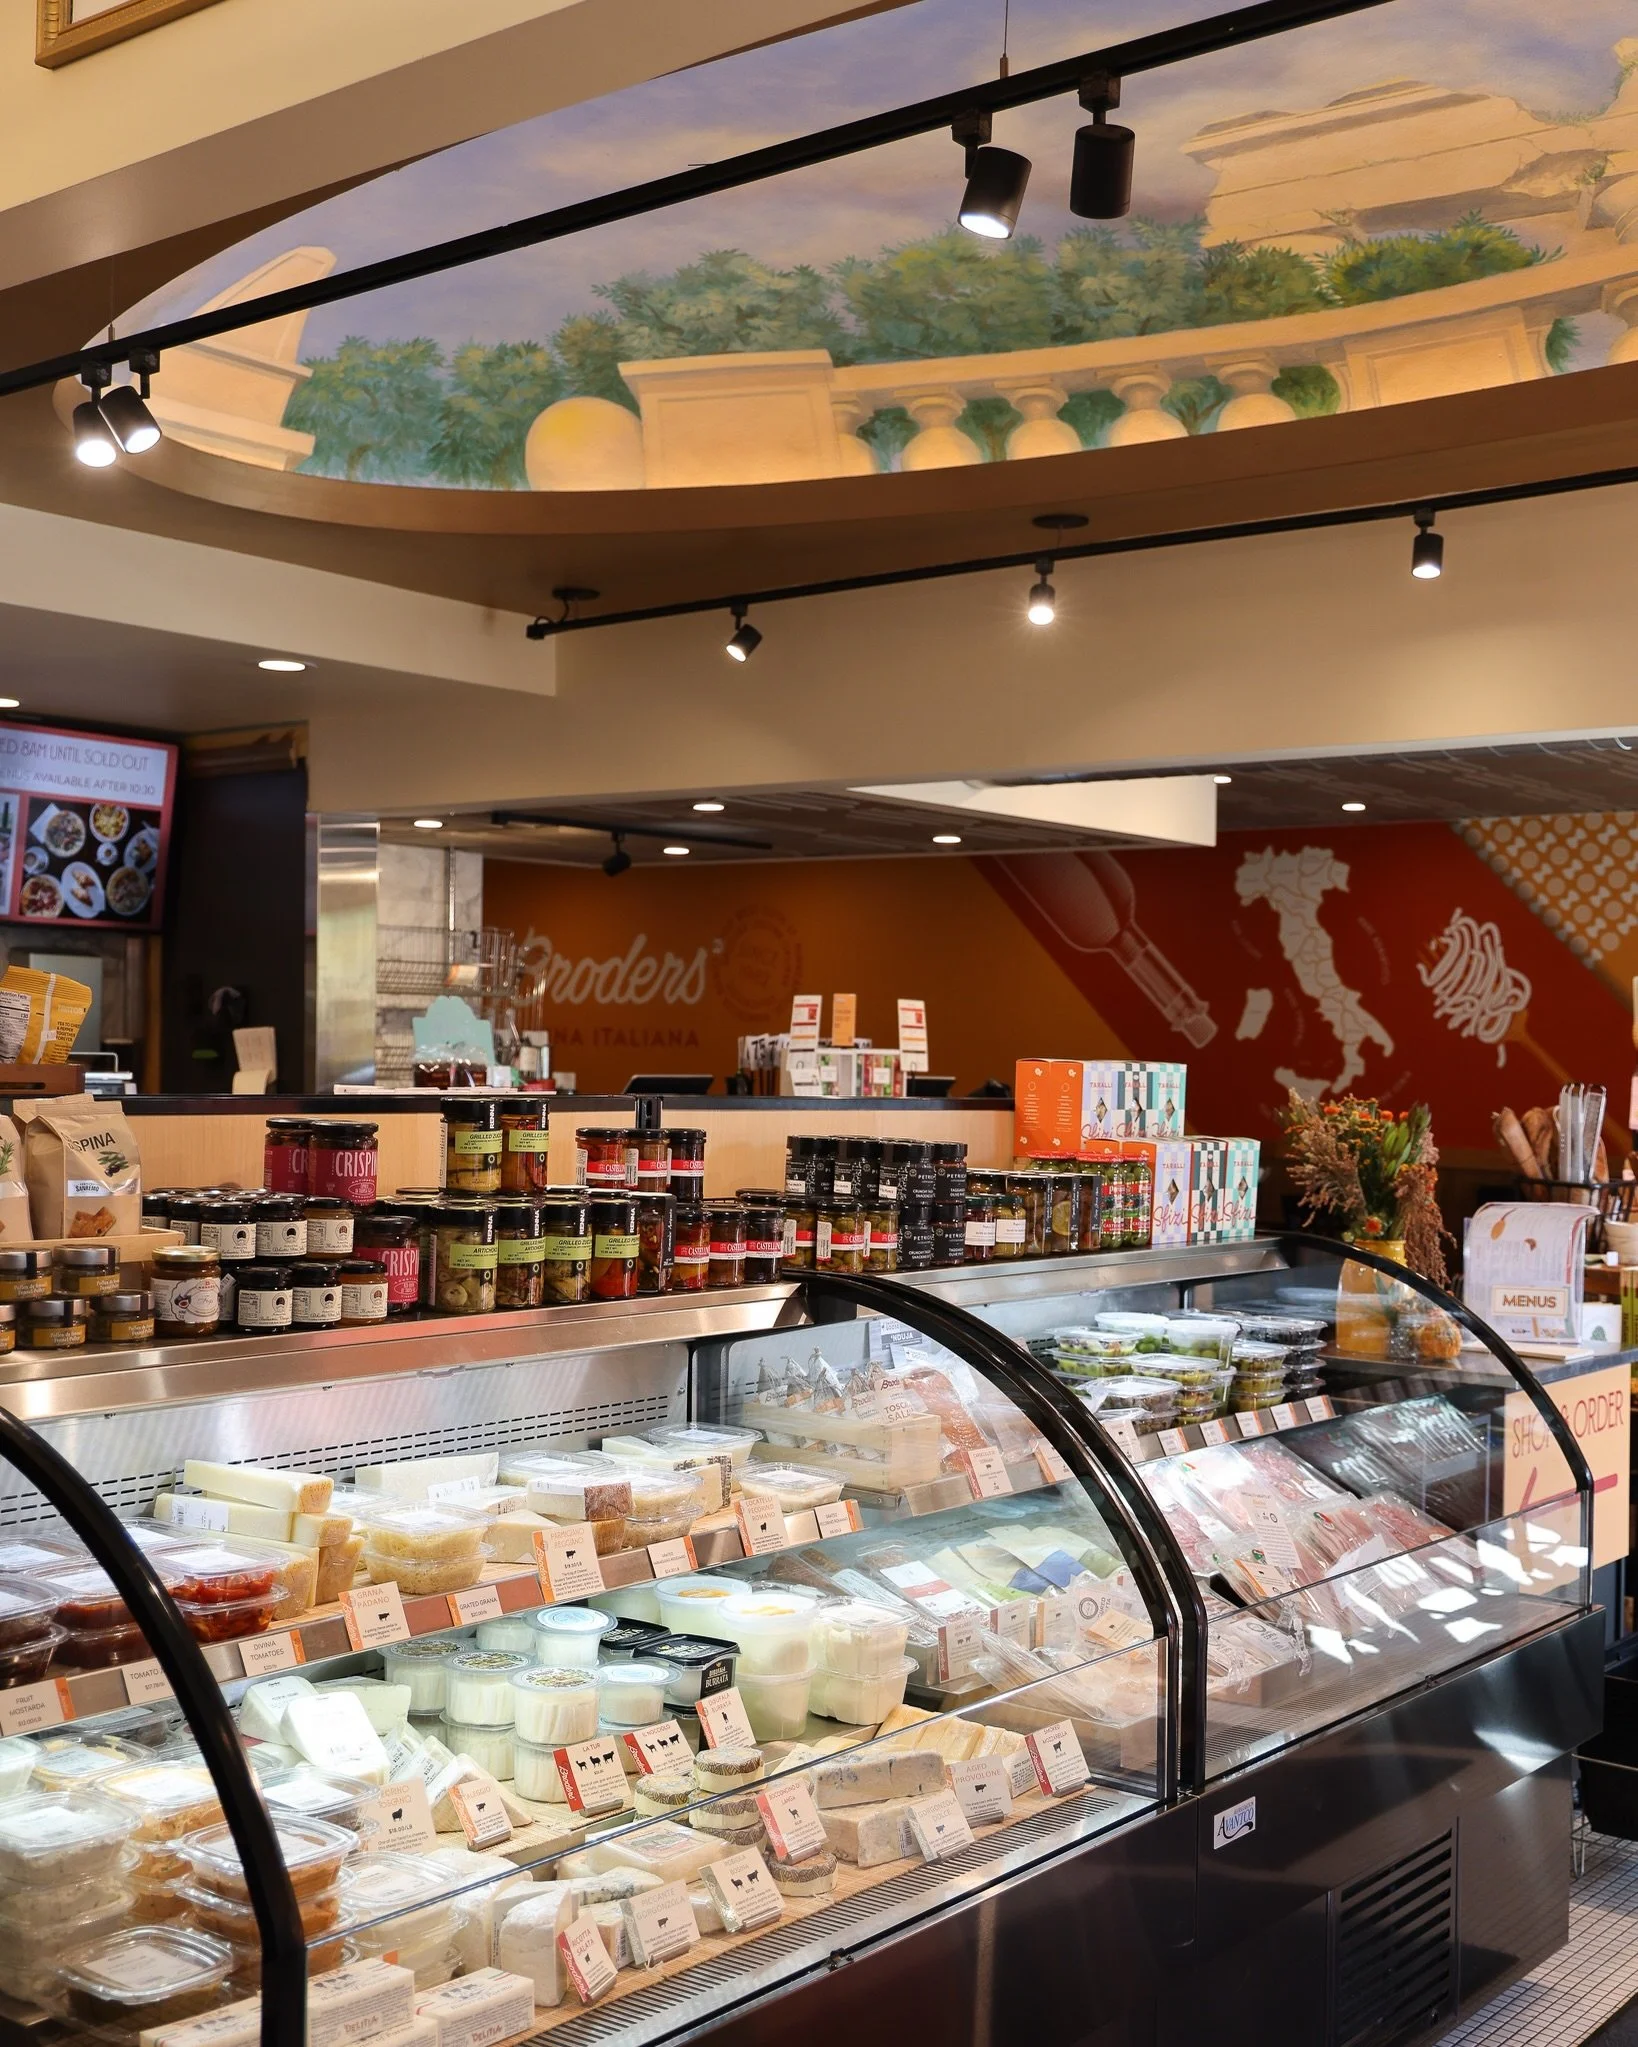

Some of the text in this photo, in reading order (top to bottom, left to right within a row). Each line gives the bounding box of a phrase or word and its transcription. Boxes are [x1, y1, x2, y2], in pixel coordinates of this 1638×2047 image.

[84, 749, 121, 768] SOLD
[122, 754, 150, 772] OUT
[1502, 1294, 1557, 1308] MENUS
[1573, 1390, 1625, 1439] ORDER
[356, 1588, 384, 1600] GRANA
[357, 1596, 390, 1609] PADANO
[459, 1597, 498, 1610] GRATED GRANA
[250, 1648, 285, 1661] TOMATOES
[130, 1668, 160, 1680] TOMATO
[15, 1695, 35, 1704] FRUIT
[9, 1703, 46, 1716] MOSTARDA
[966, 1763, 987, 1773] AGED
[955, 1769, 1001, 1784] PROVOLONE
[571, 1929, 592, 1947] RICOTTA
[577, 1938, 594, 1955] SALATA
